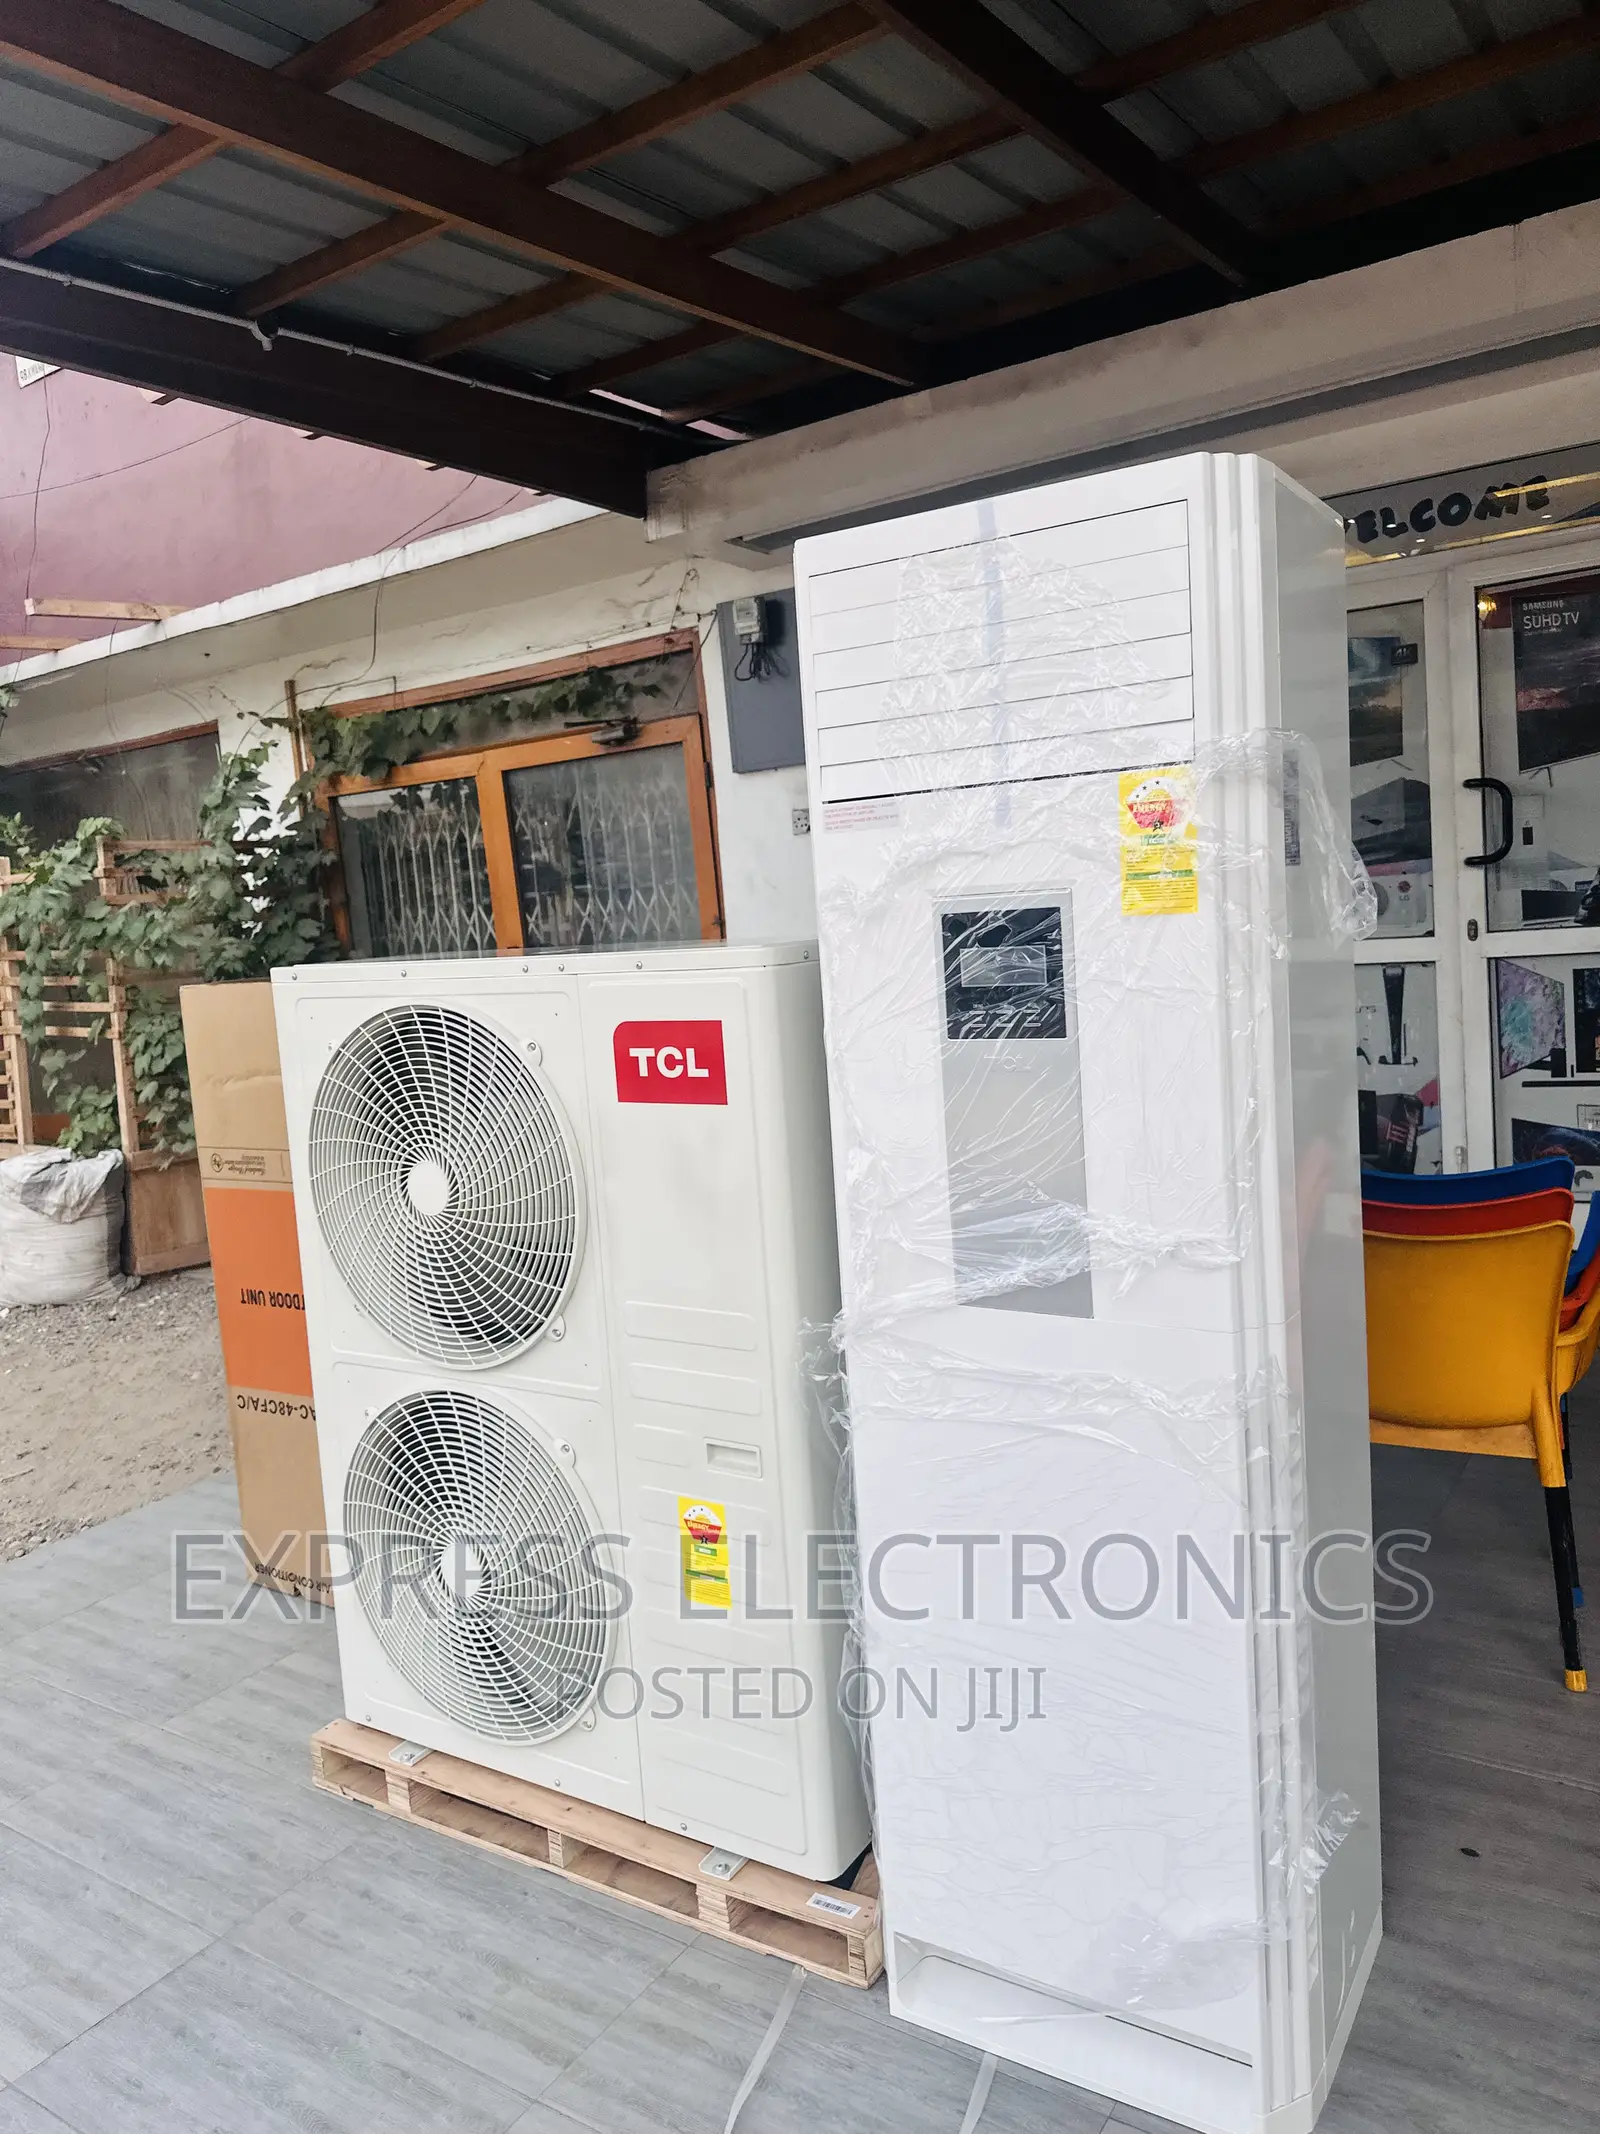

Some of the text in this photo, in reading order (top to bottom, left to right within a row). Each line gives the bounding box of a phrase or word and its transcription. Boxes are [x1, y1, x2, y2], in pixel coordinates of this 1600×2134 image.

[1346, 474, 1550, 543] ELCOME
[1522, 599, 1564, 611] SAMSUNG
[1523, 611, 1580, 630] SUHD TV
[628, 1046, 710, 1079] TCL
[240, 1287, 266, 1307] UNIT
[254, 1562, 331, 1594] AIR CONDITIONER
